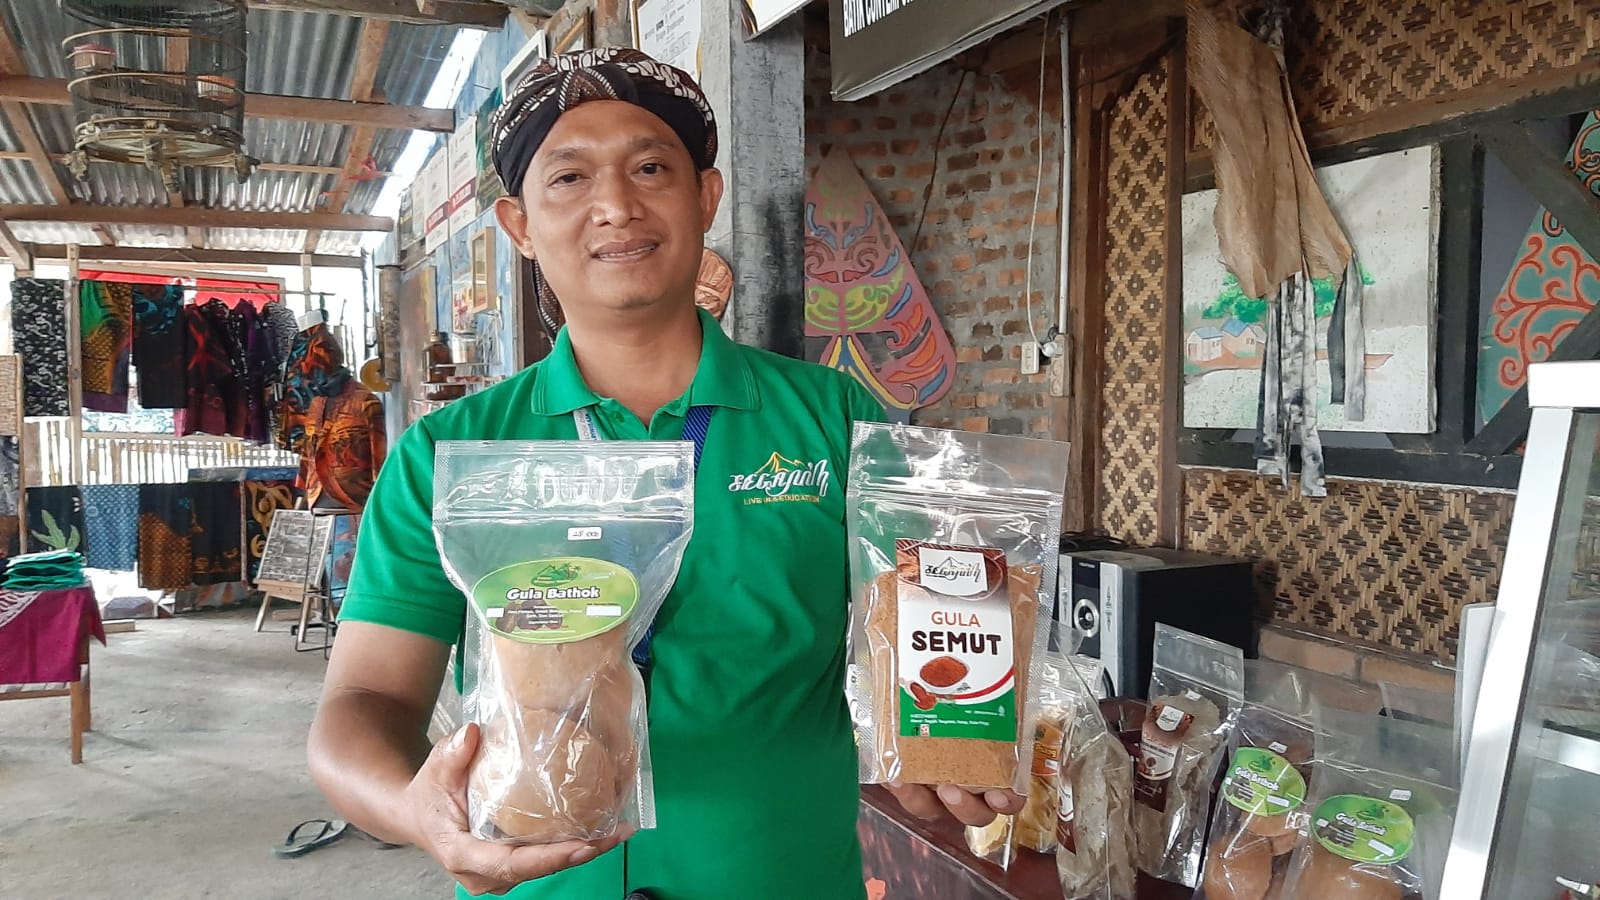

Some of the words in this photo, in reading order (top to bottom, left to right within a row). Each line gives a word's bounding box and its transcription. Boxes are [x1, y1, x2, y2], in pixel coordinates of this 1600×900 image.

[843, 0, 866, 37] BATIK
[744, 497, 762, 506] LIVE
[506, 588, 543, 600] Gula
[546, 586, 600, 599] Bathok
[931, 611, 982, 628] GULA
[911, 630, 1002, 655] SEMUT
